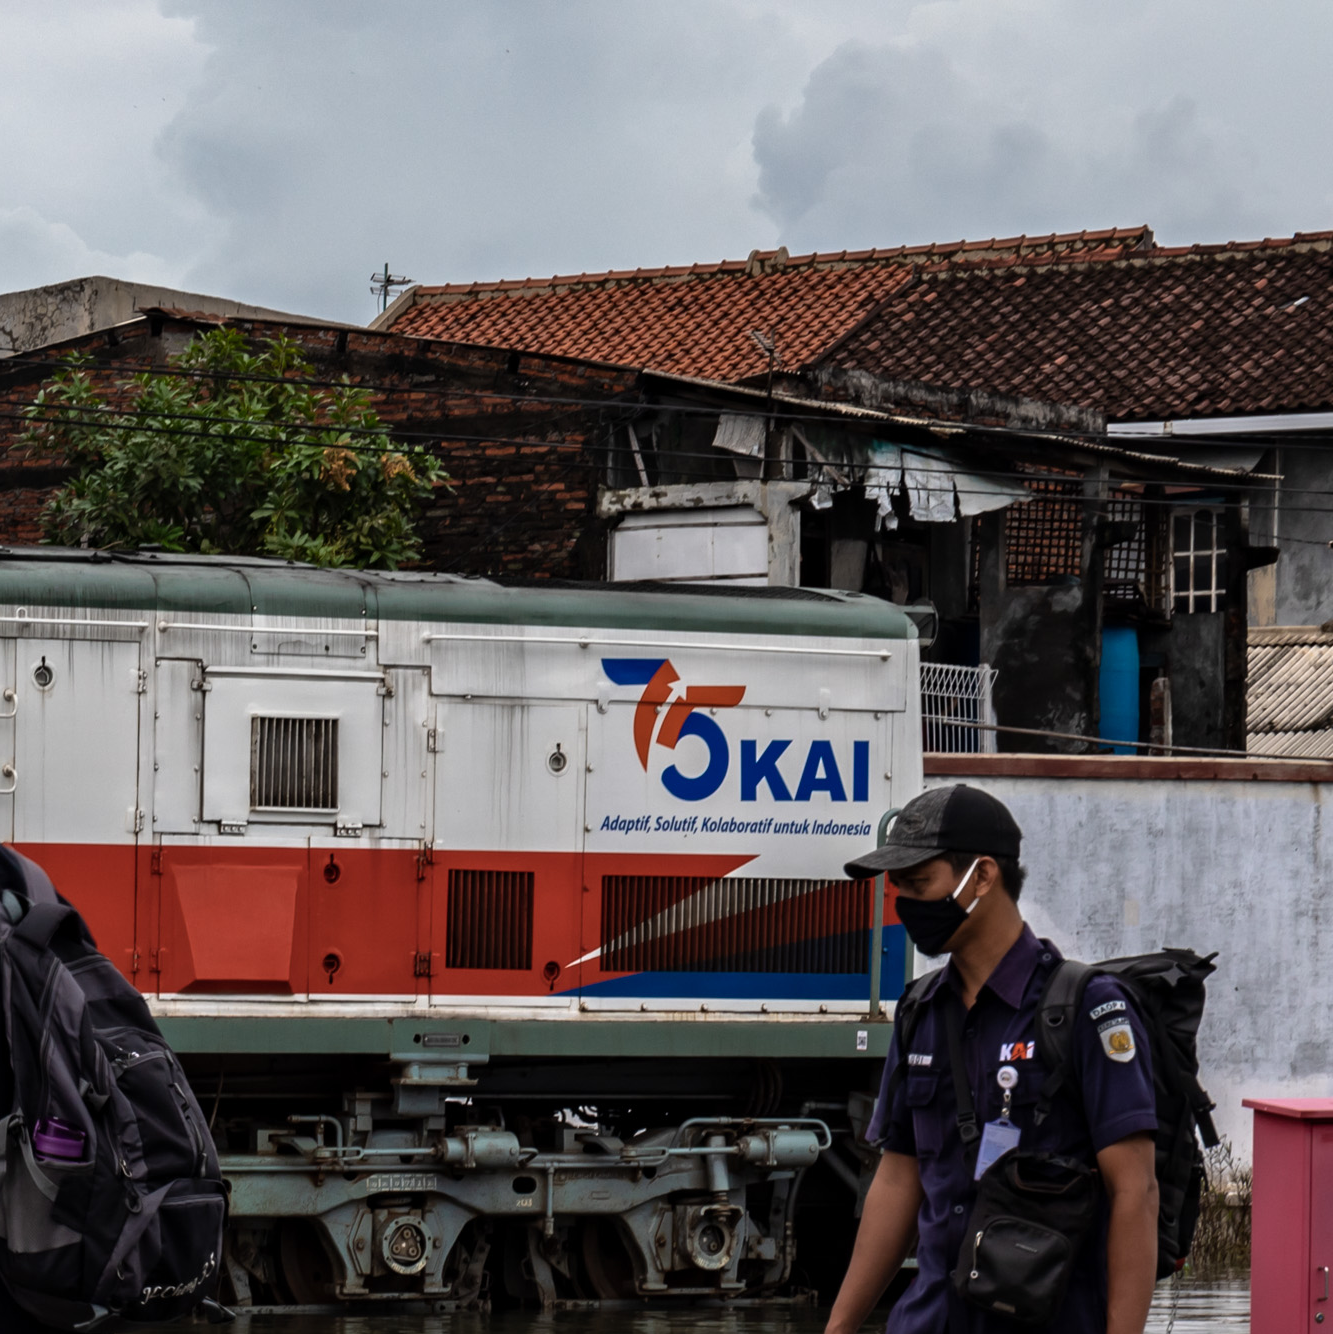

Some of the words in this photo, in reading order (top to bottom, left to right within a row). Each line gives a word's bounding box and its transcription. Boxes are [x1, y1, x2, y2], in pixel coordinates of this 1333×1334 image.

[740, 739, 870, 802] KAI
[600, 815, 653, 833] Adaptif,
[654, 815, 698, 834] Solutif,
[701, 816, 773, 835] Kolaboratif
[773, 820, 810, 835] untuk
[811, 820, 871, 836] Indonesia
[999, 1041, 1035, 1062] KAI
